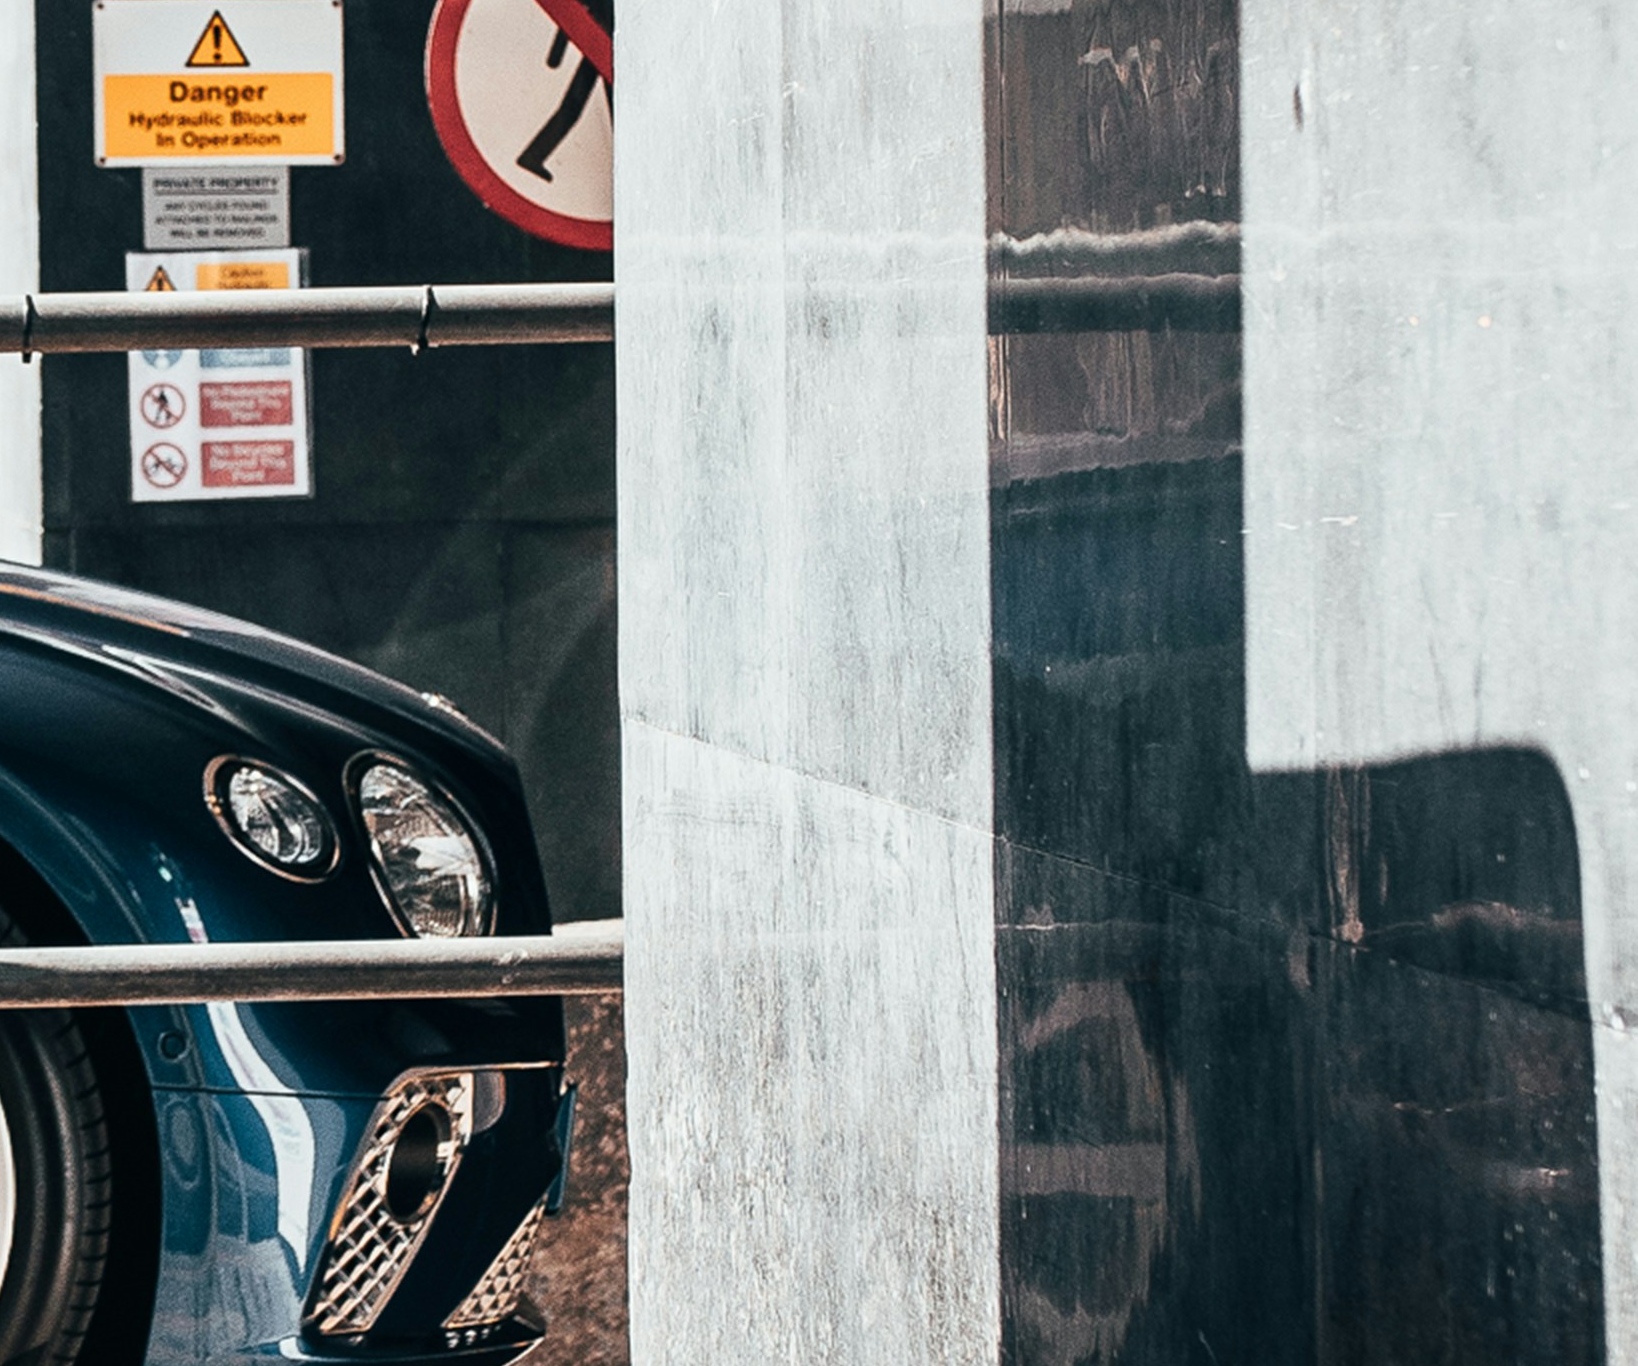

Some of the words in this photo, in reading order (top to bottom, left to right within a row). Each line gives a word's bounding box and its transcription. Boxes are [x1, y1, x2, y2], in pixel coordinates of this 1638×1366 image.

[169, 81, 267, 106] Danger
[129, 112, 223, 130] Hydraulic
[230, 110, 307, 126] Blocker
[156, 133, 175, 147] In
[181, 131, 281, 150] Operation
